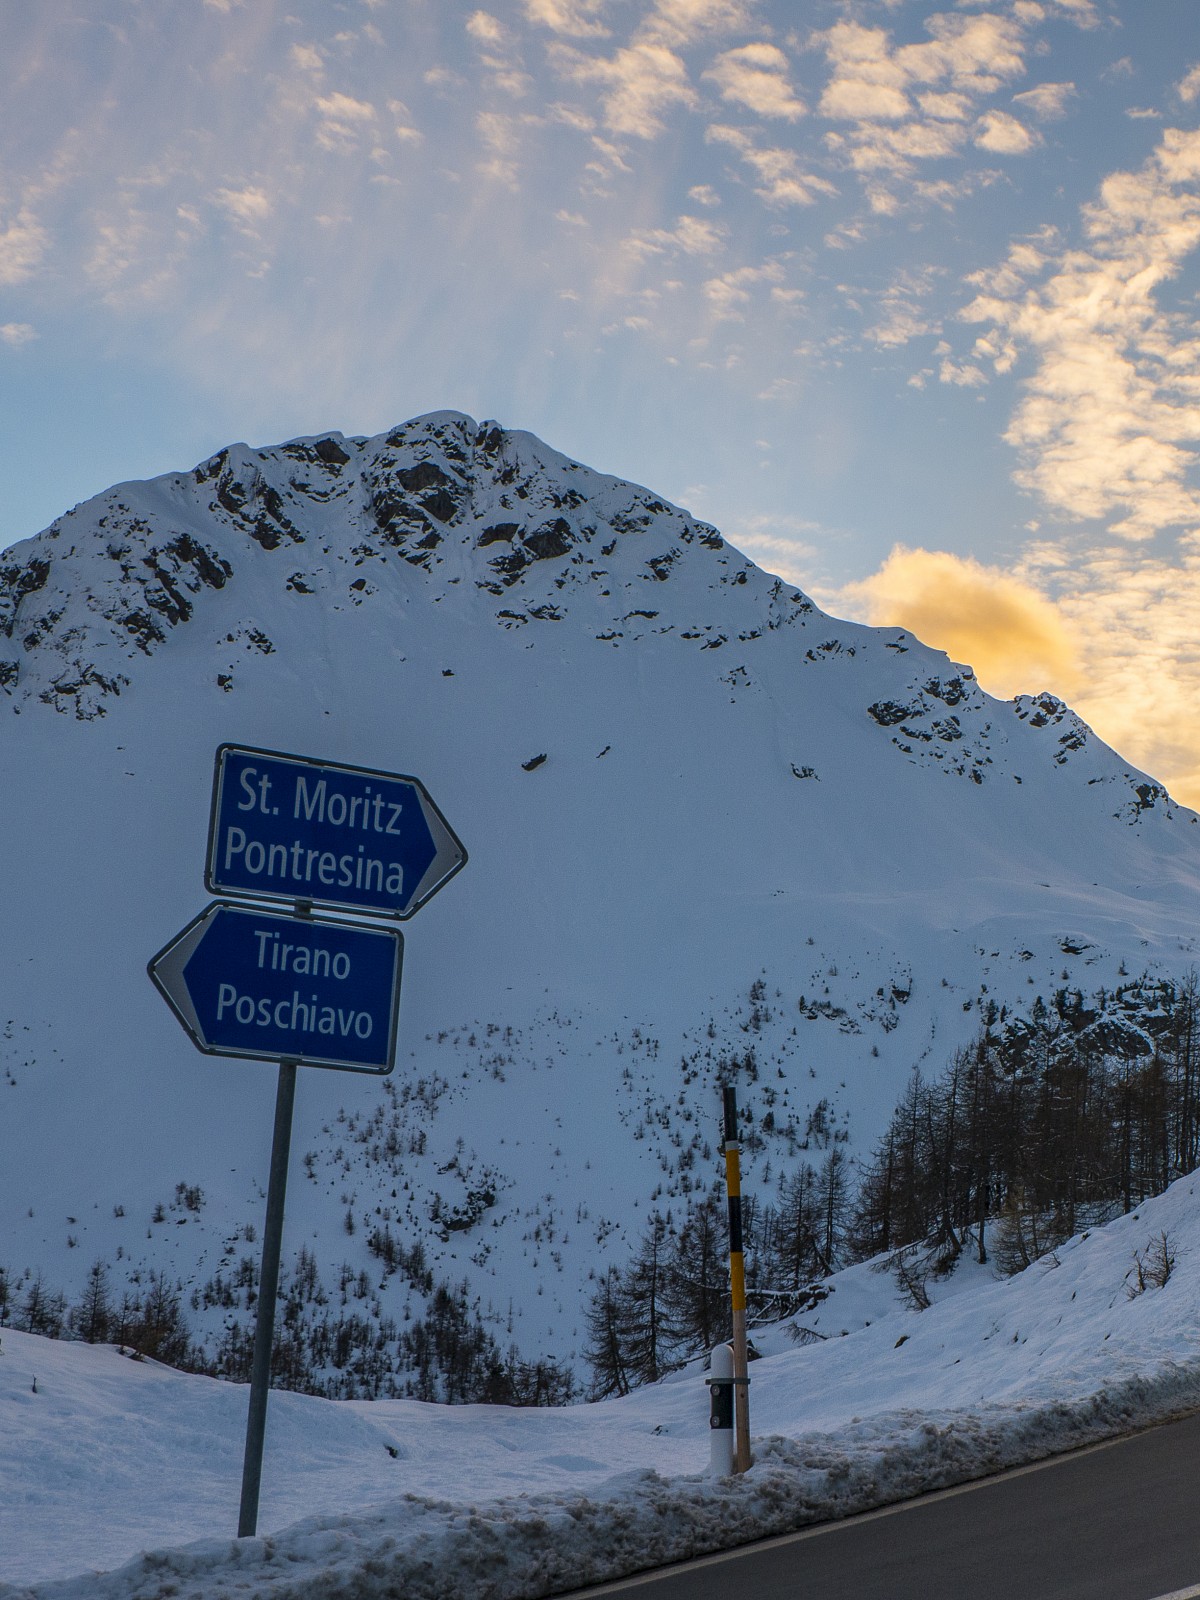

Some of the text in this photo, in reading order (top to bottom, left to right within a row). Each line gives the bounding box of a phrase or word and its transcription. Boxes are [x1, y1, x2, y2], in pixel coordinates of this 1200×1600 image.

[237, 767, 403, 835] St. Moritz
[224, 826, 404, 895] Pontresina
[254, 930, 351, 980] Tirano
[216, 983, 373, 1039] Poschiavo
